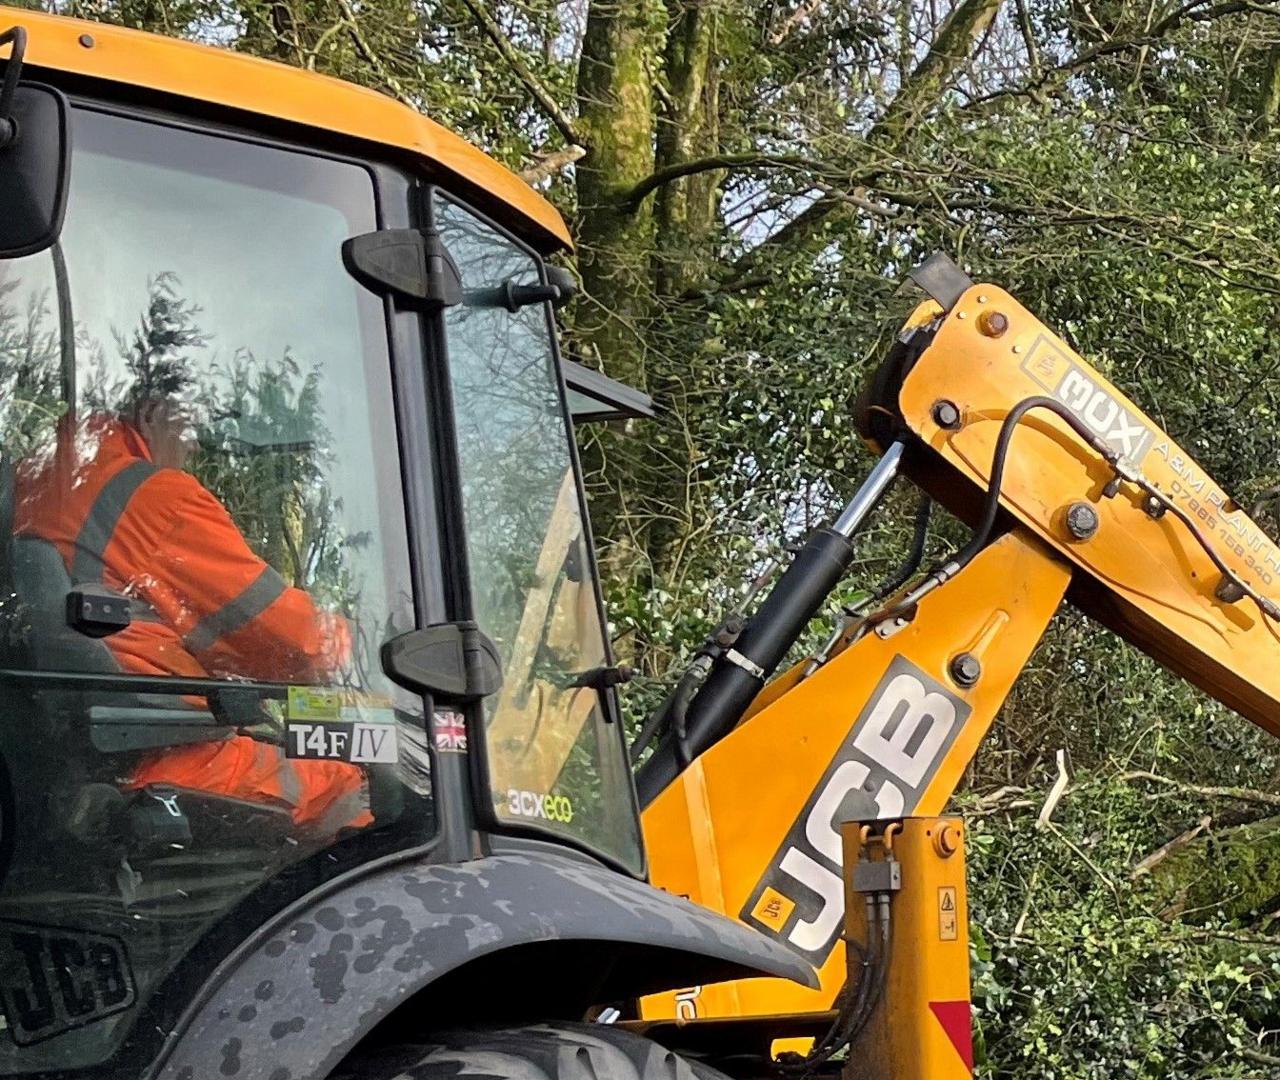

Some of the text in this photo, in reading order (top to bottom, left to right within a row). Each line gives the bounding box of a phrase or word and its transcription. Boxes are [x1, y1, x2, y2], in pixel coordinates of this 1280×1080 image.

[1153, 442, 1206, 494] A&M
[1203, 489, 1267, 553] PLANT
[1244, 555, 1273, 586] 340
[779, 674, 956, 951] JCB
[12, 934, 128, 1031] JCB
